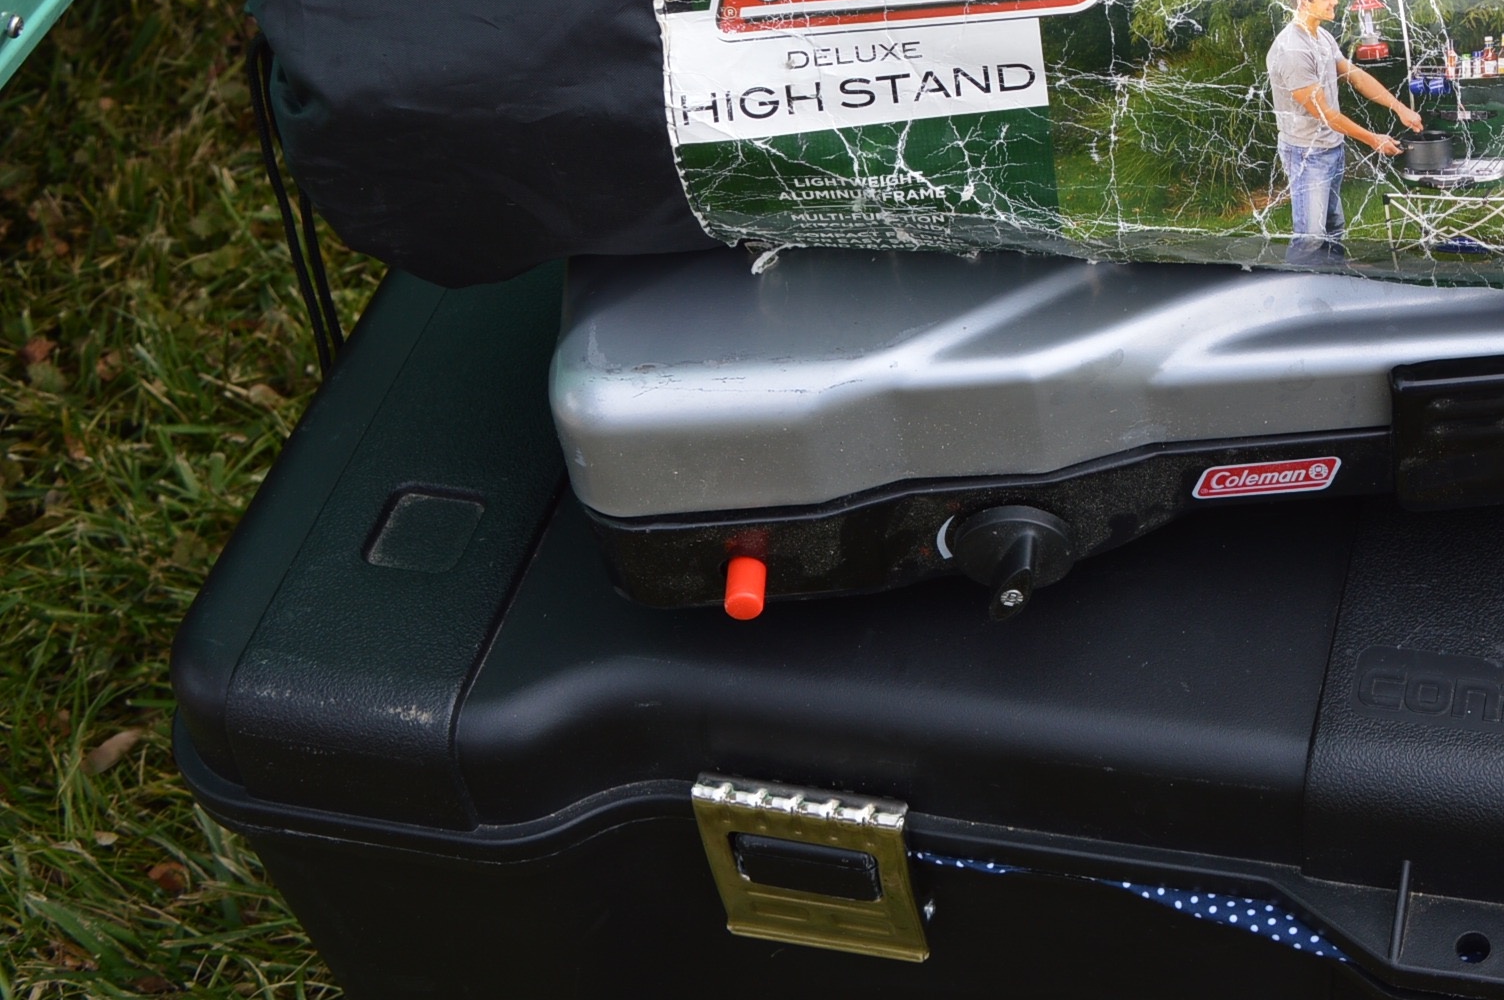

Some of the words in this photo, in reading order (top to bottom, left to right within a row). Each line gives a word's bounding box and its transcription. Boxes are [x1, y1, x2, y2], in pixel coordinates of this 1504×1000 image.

[787, 41, 923, 70] DELUXE
[680, 81, 824, 126] HIGH
[839, 62, 1036, 109] STAND
[793, 171, 924, 188] LIGHTWEIGHT
[882, 188, 946, 201] FRAME
[1210, 469, 1306, 490] Coleman
